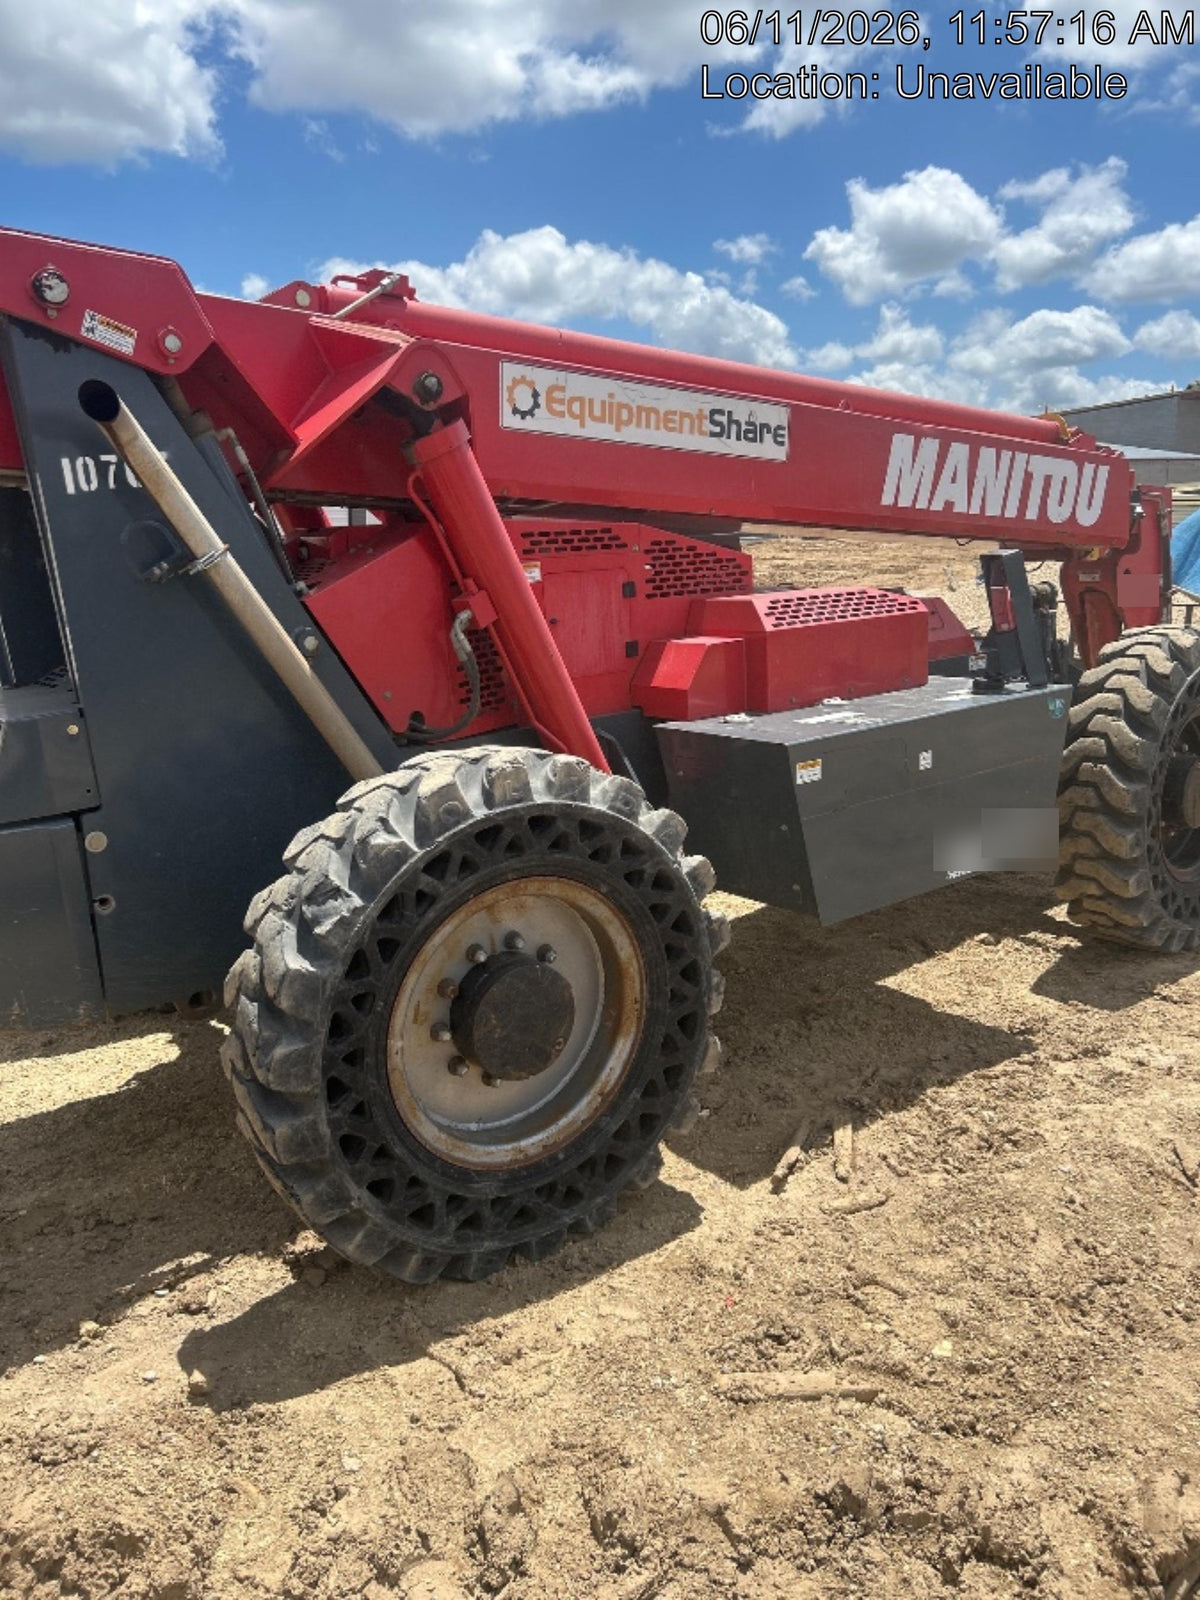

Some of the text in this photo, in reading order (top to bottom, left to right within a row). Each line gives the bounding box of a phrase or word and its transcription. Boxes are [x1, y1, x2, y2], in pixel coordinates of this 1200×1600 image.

[545, 383, 787, 447] EquipmentShare
[61, 451, 168, 494] 107
[880, 433, 1110, 527] MANITOU
